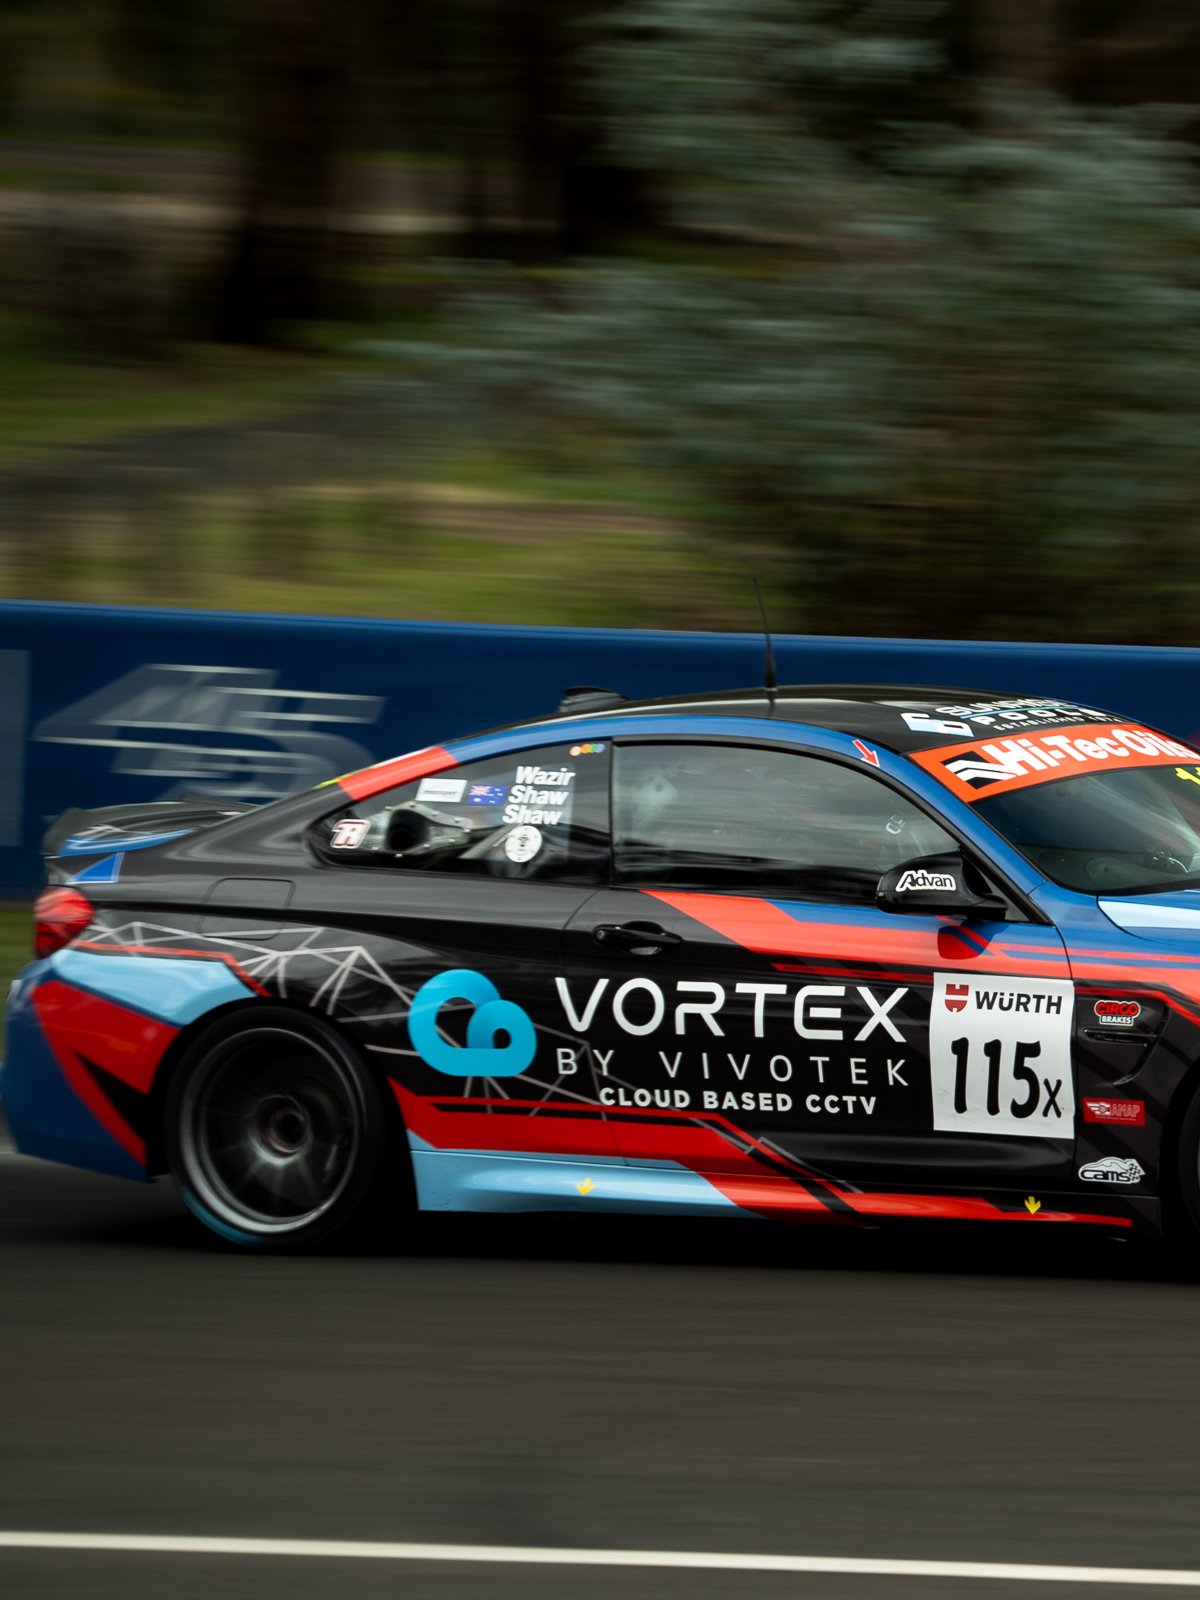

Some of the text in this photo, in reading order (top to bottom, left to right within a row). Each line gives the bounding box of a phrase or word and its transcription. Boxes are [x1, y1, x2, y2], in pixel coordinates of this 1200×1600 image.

[515, 766, 576, 786] Wazir
[508, 785, 569, 805] Shaw
[503, 805, 563, 826] Shaw
[898, 871, 955, 890] Advan
[555, 977, 909, 1043] VORTEX
[975, 991, 1063, 1015] WÜRTH
[1101, 1015, 1132, 1024] BRAKES
[556, 1048, 909, 1086] BY VIVOTEK
[600, 1087, 877, 1115] CLOUD BASED CCTV
